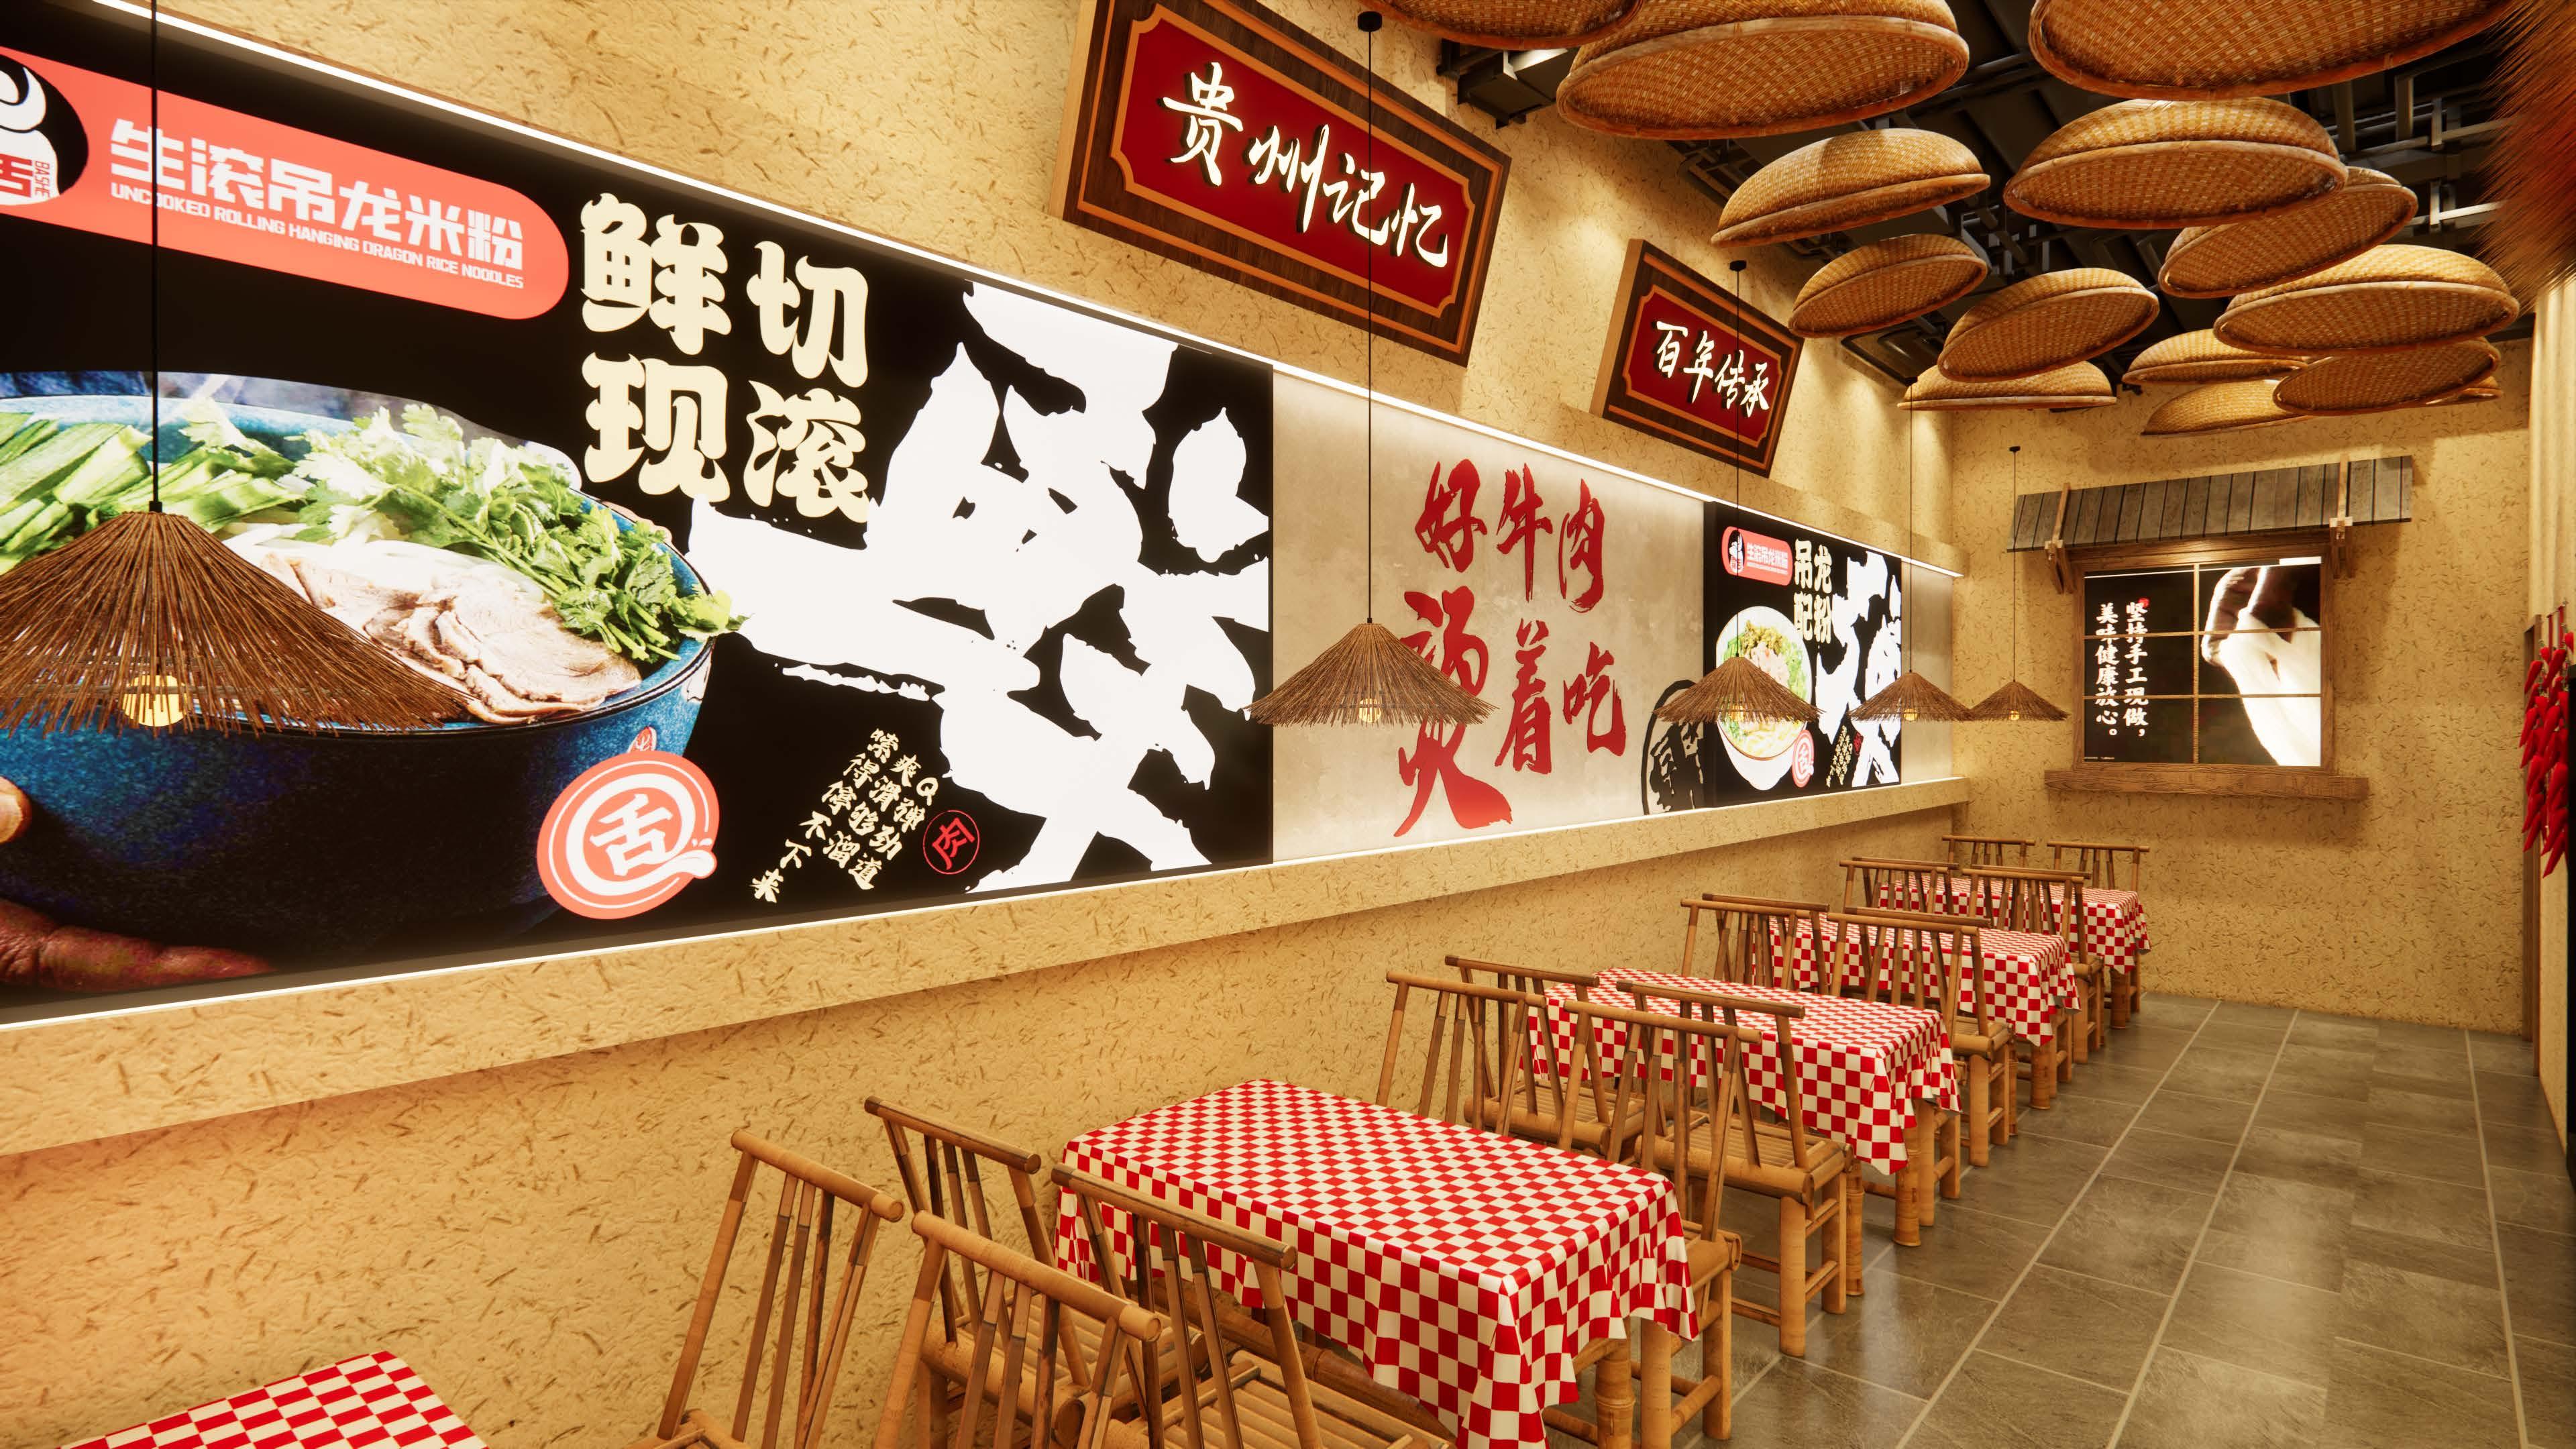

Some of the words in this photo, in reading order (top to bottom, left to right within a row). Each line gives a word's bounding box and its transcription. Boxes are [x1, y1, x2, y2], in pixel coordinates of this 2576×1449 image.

[111, 118, 523, 270] 生滚吊龙米粉
[1163, 62, 1448, 267] 贵州记忆
[214, 205, 286, 235] ROLLING
[288, 223, 360, 252] HANGING
[362, 240, 424, 267] DRAGON
[426, 255, 459, 275] RICE
[462, 262, 524, 289] NOODLES
[580, 193, 869, 388] 鲜切
[1656, 321, 1770, 417] 百年传承
[582, 352, 869, 523] 现滚
[1415, 459, 1605, 613] 好牛肉
[1794, 538, 1832, 594] 吊龙
[1793, 591, 1832, 644] 配粉
[849, 777, 939, 890] Q弹劲道
